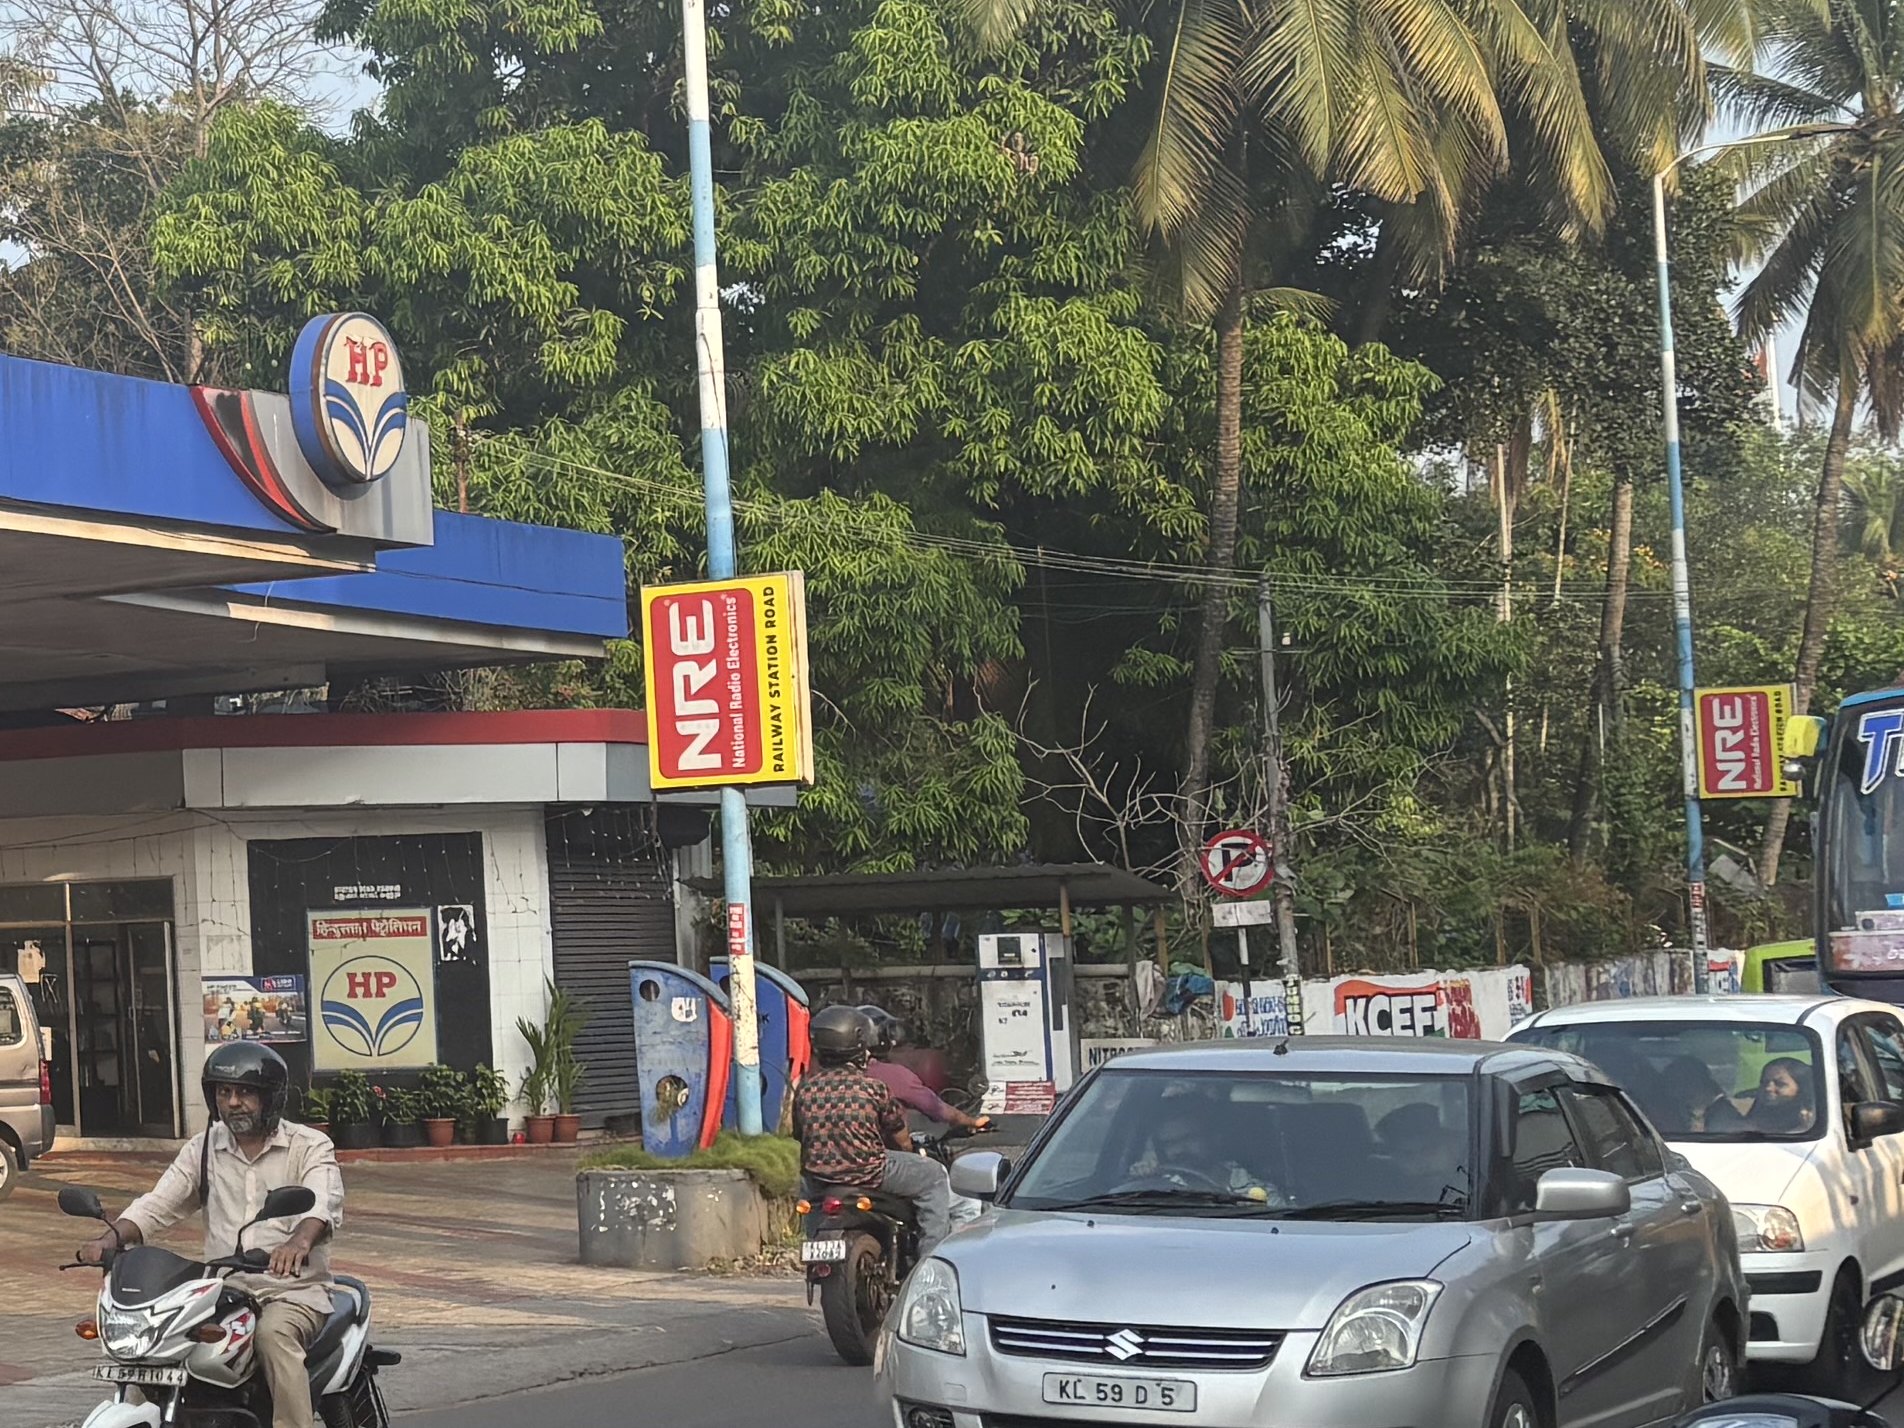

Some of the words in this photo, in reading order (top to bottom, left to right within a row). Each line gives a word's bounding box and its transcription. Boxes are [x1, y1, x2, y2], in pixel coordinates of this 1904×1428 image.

[344, 336, 389, 387] HP
[724, 597, 740, 669] Electronics
[763, 586, 777, 629] ROAD
[668, 599, 722, 771] NRE
[727, 673, 742, 709] Radio
[765, 634, 781, 698] STATION
[731, 713, 746, 768] National
[768, 705, 784, 772] RAILWAY
[1713, 696, 1747, 790] NRE
[346, 972, 397, 999] HP
[1059, 1379, 1086, 1400] KL
[1096, 1383, 1123, 1402] 59
[1135, 1385, 1148, 1404] D
[1161, 1387, 1175, 1406] 5
